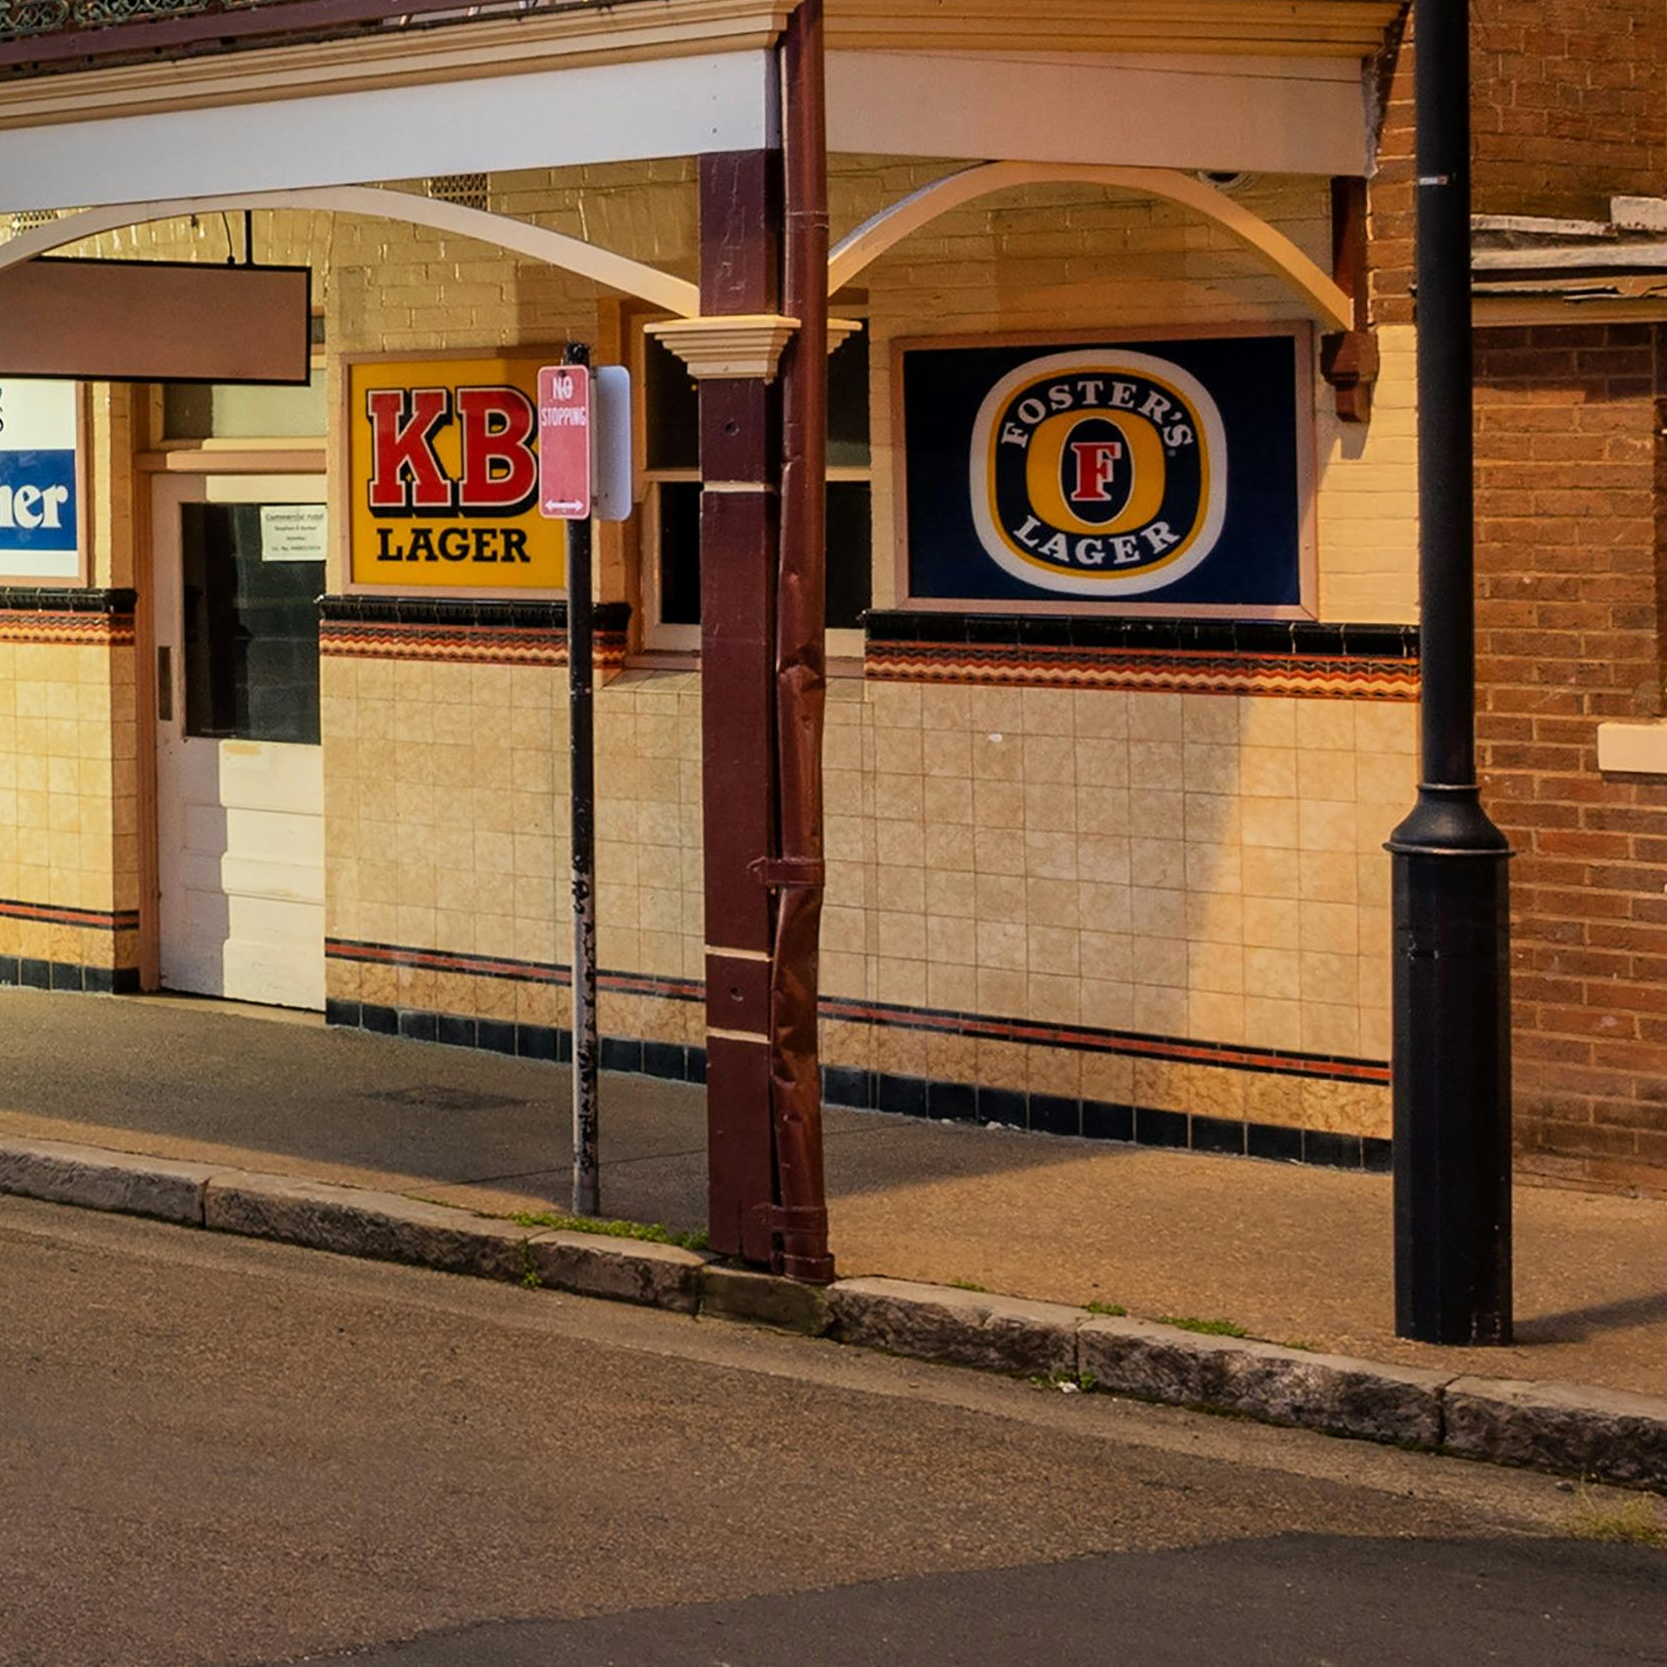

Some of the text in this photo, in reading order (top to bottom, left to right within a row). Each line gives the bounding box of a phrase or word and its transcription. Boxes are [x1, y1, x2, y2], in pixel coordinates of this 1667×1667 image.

[552, 376, 573, 401] NO
[541, 407, 587, 427] STOPPING
[1001, 380, 1194, 449] FOSTER'S
[367, 386, 539, 517] KB
[1070, 442, 1122, 502] F
[376, 527, 531, 563] LAGER
[1013, 514, 1181, 565] LAGER
